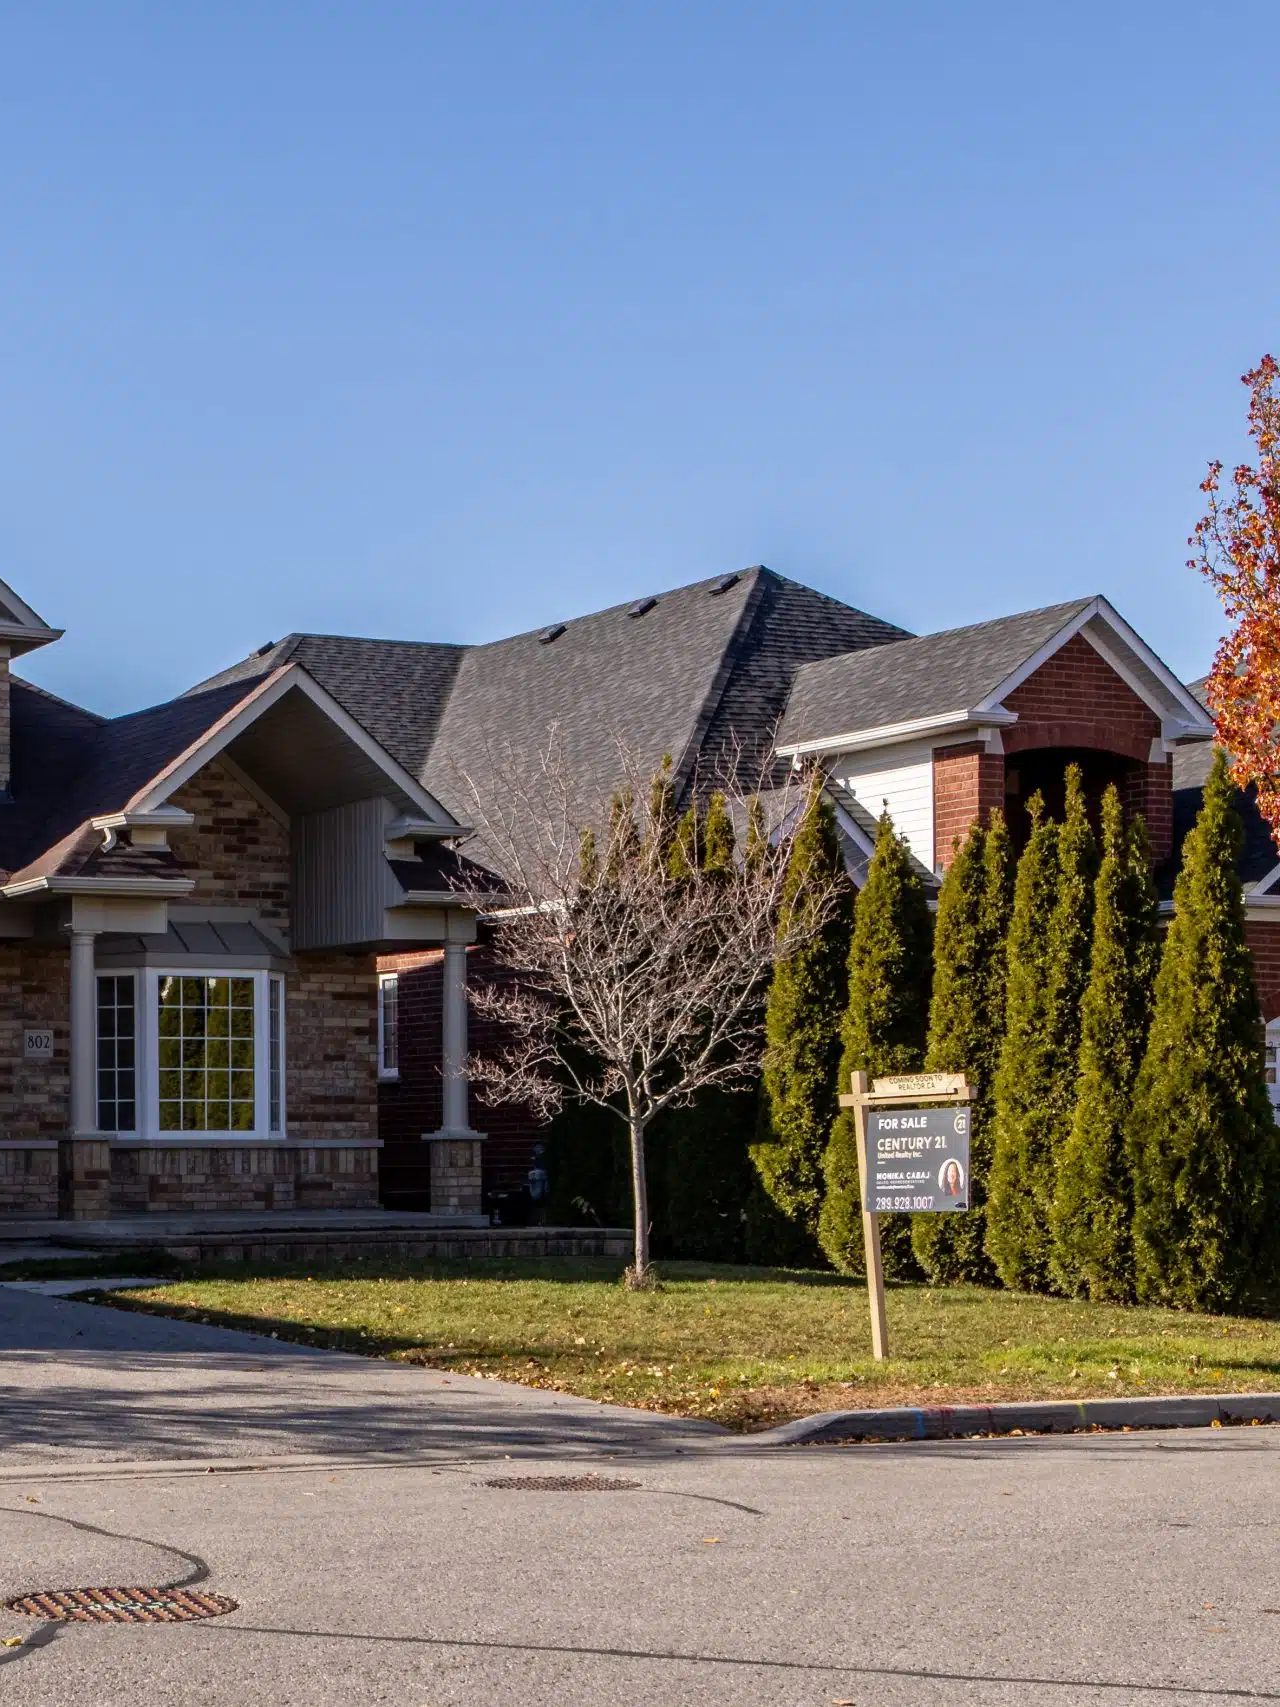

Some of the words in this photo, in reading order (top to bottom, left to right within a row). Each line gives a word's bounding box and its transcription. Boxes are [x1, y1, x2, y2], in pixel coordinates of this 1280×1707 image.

[27, 1035, 50, 1049] 802
[889, 1076, 914, 1084] COMING
[915, 1075, 933, 1083] SOON
[878, 1119, 898, 1130] FOR
[900, 1117, 928, 1129] SALE
[877, 1136, 933, 1151] CENTURY
[876, 1172, 904, 1180] MONIKA
[875, 1196, 934, 1210] 289.928.1007
